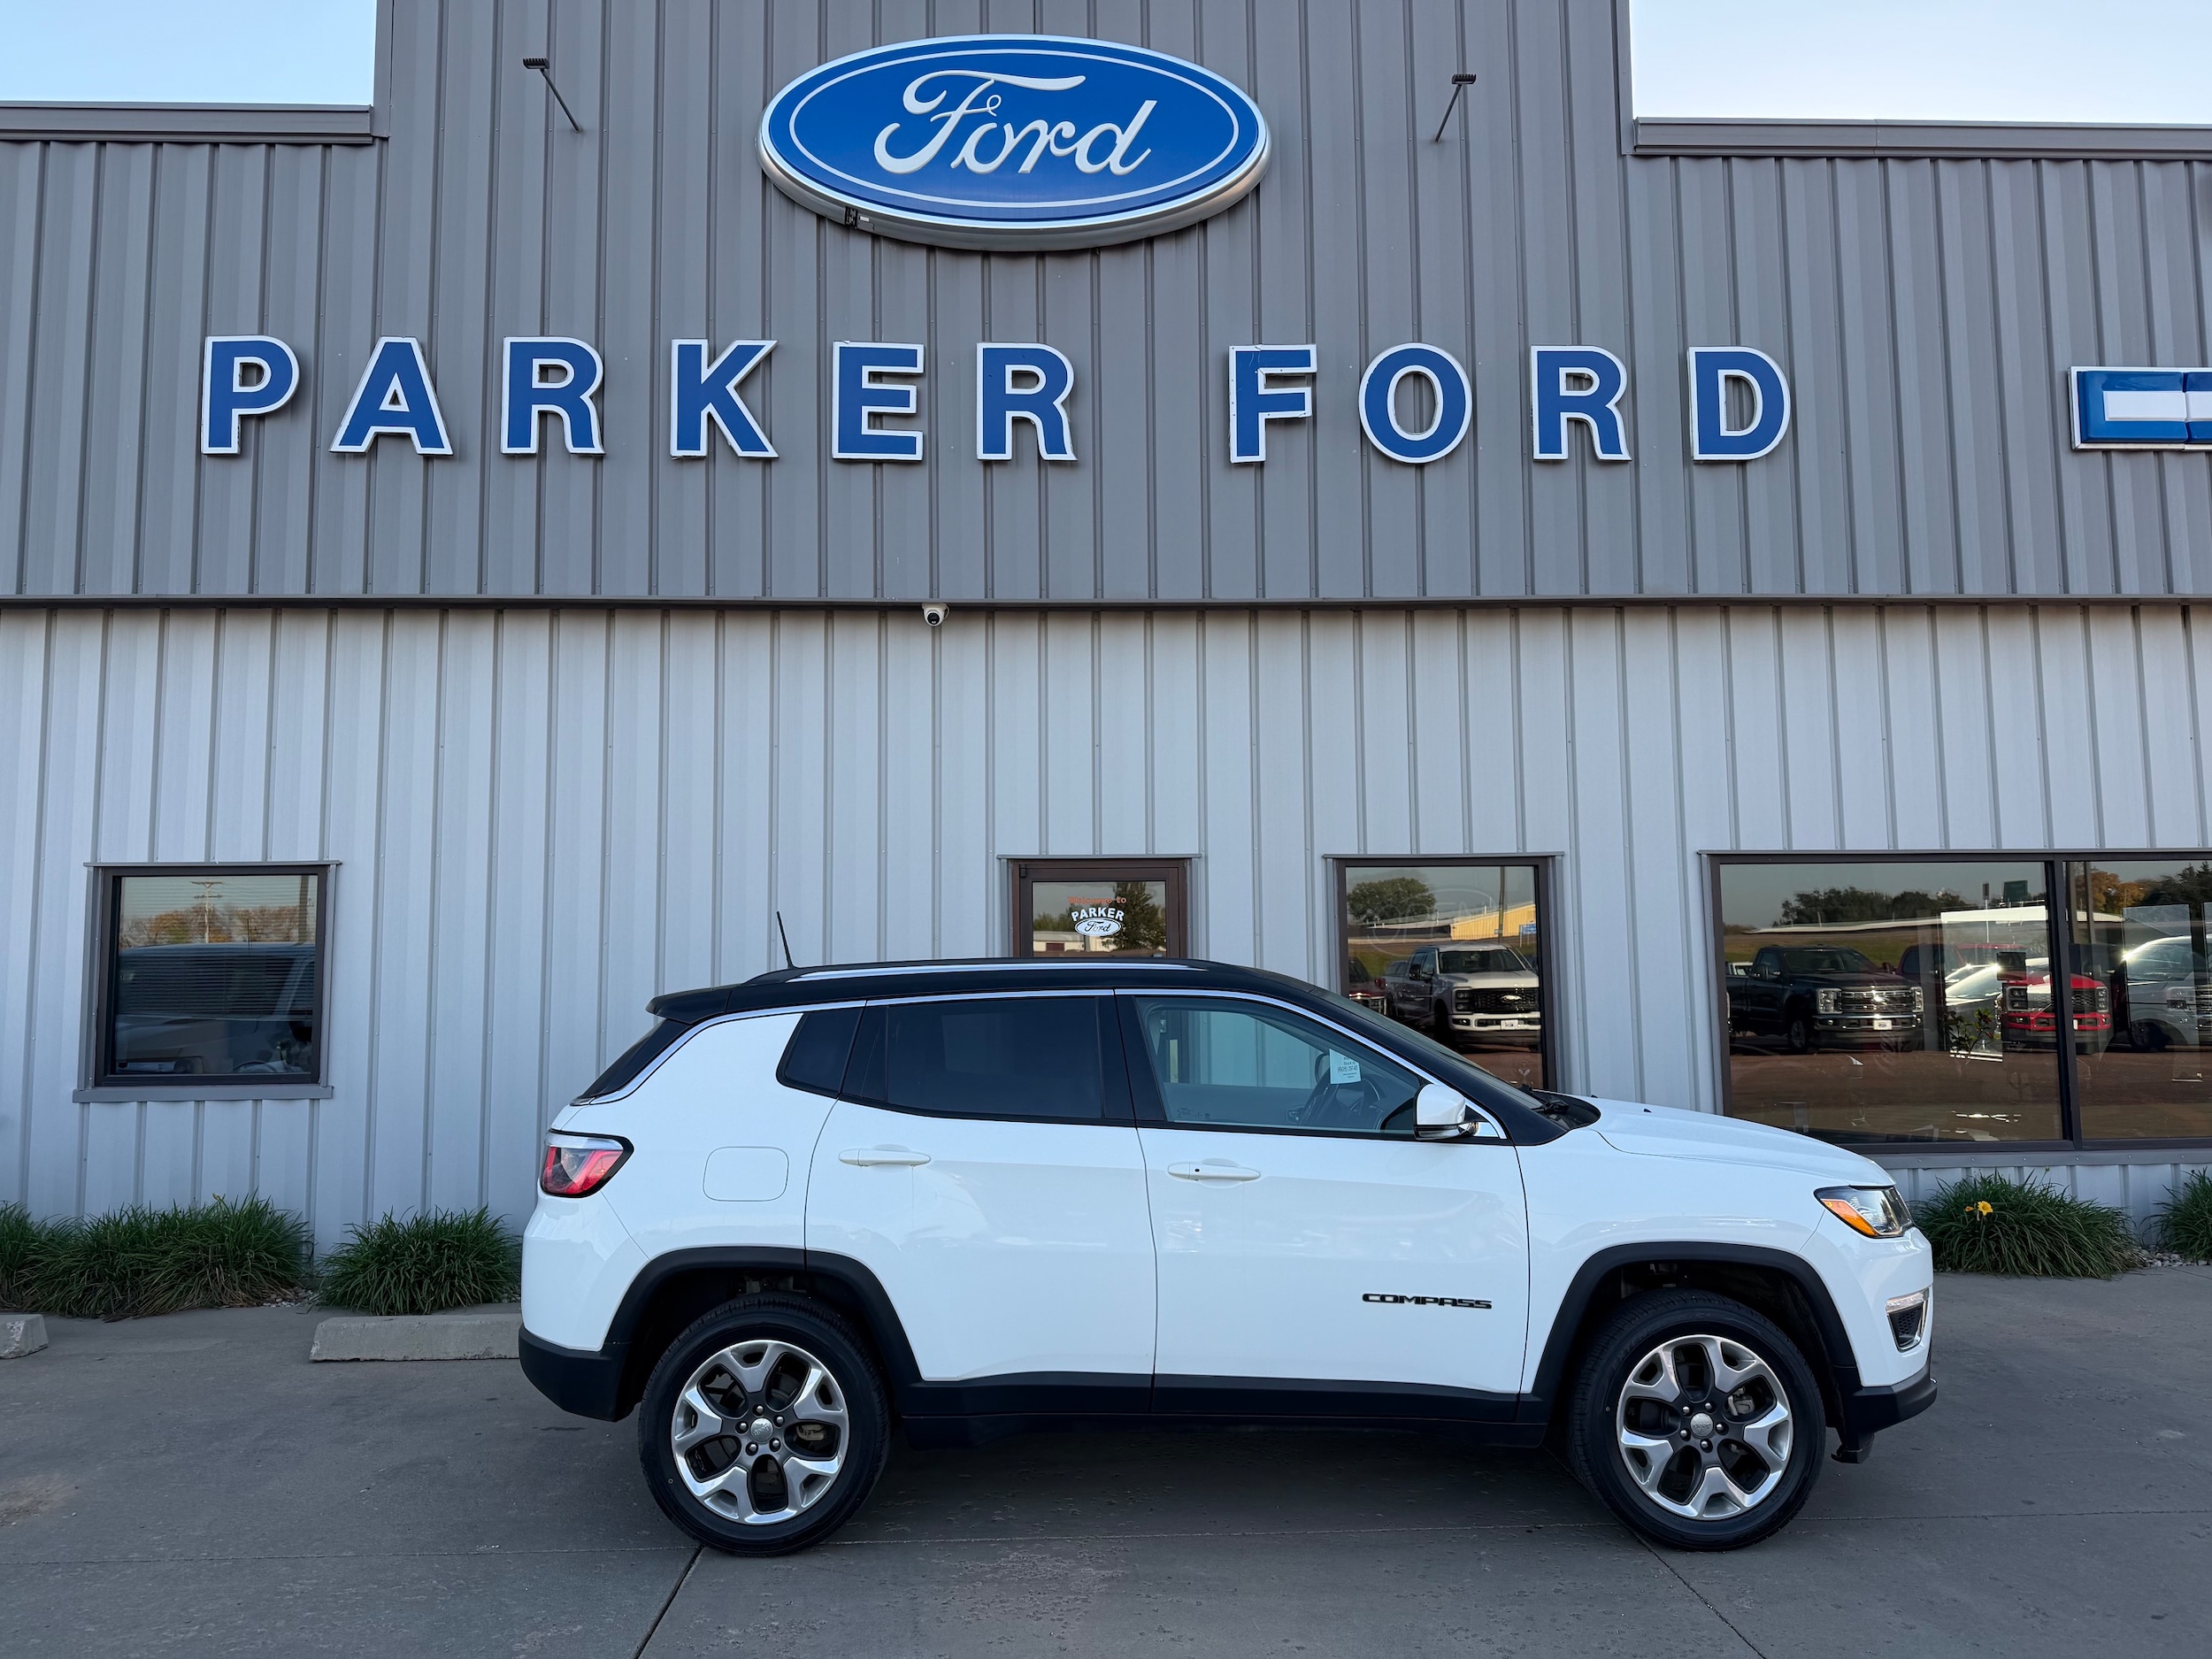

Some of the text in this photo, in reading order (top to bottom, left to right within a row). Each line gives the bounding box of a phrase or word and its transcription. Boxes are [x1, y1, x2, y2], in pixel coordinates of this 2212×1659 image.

[873, 69, 1158, 176] Ford
[201, 335, 1791, 464] PARKER FORD
[1071, 907, 1125, 922] PARKER
[1084, 921, 1111, 933] Ford
[1362, 1293, 1493, 1310] COMPASS
